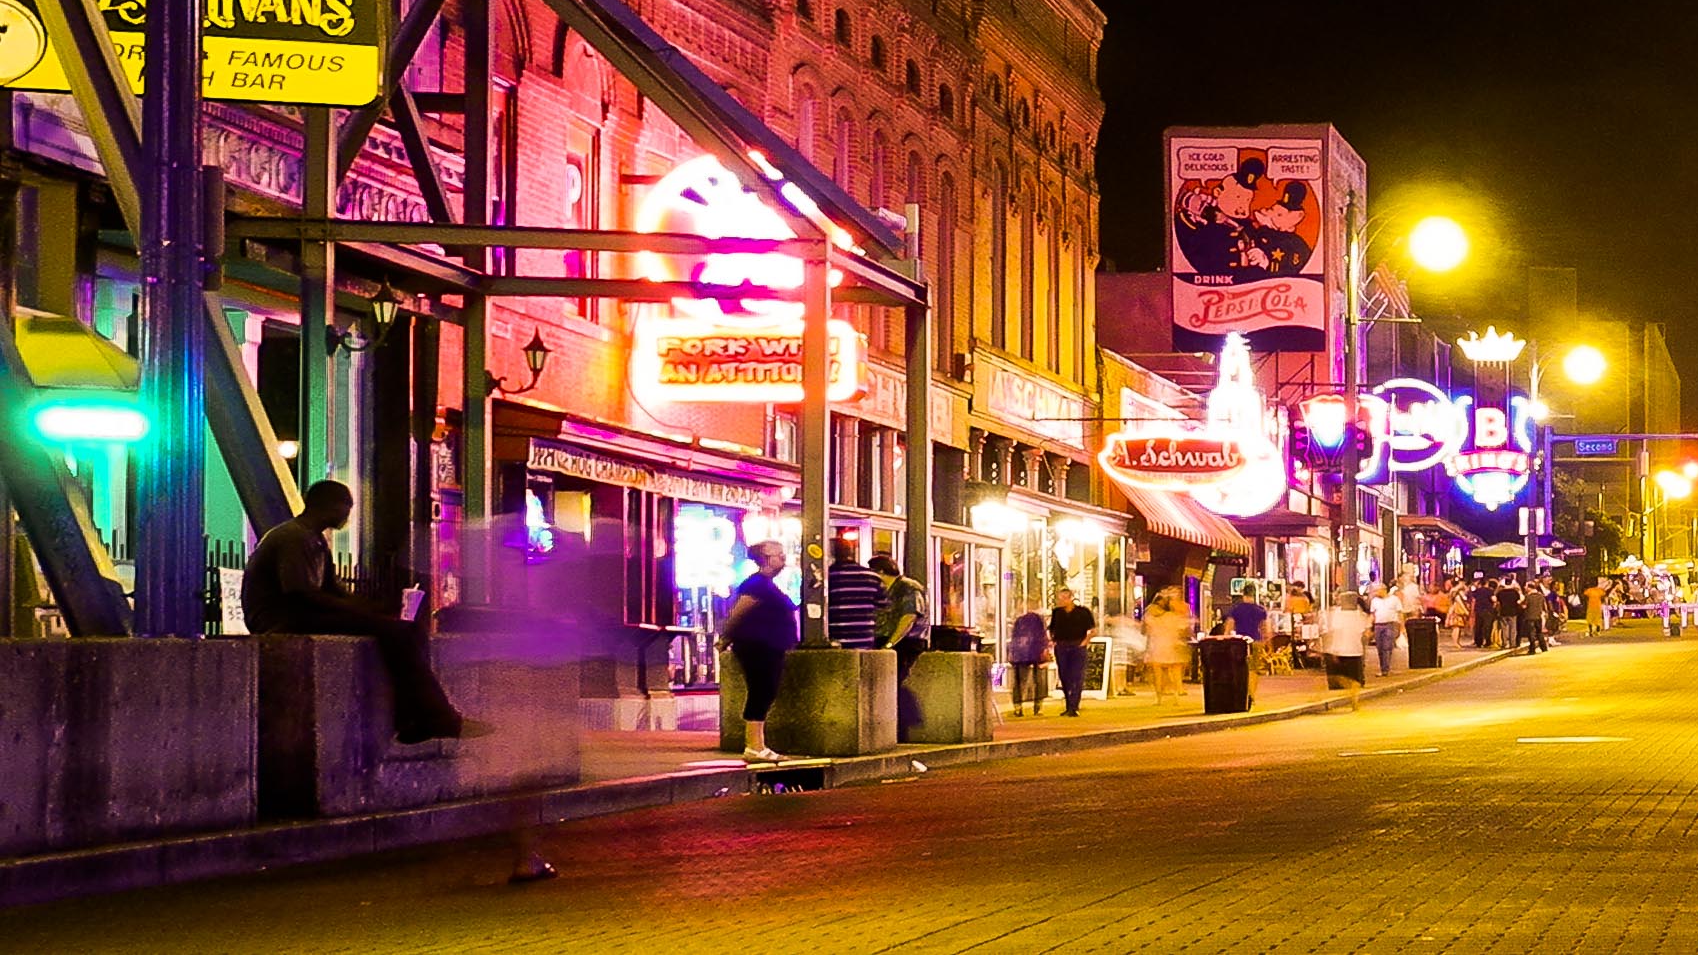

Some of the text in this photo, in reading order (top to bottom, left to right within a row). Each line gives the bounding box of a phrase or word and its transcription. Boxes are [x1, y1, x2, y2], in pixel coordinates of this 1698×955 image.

[228, 50, 346, 73] FAMOUS
[231, 72, 286, 91] BAR
[1188, 152, 1225, 161] ICE COLD
[1271, 154, 1320, 163] ARRESTING
[1194, 275, 1234, 285] DRINK
[657, 336, 748, 356] PORK
[658, 361, 841, 383] AN ATTITU!
[1140, 438, 1242, 469] Schwab
[1578, 442, 1613, 452] Second
